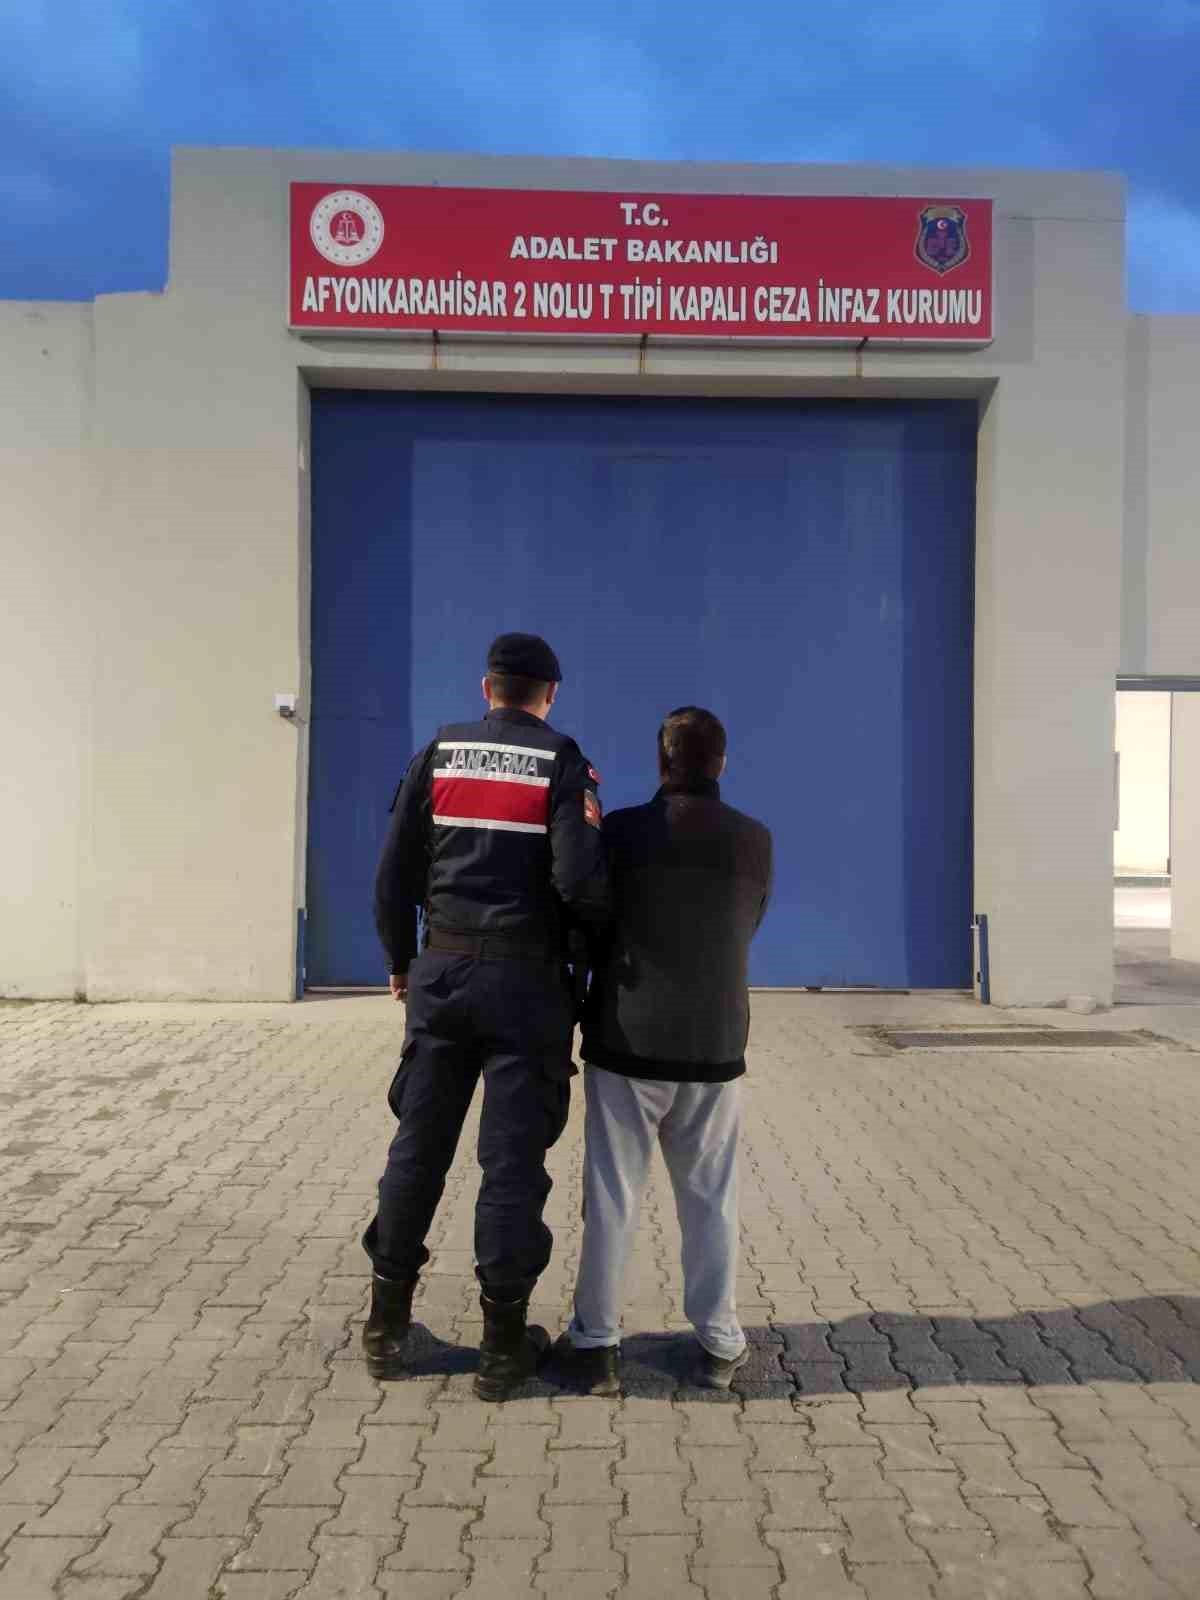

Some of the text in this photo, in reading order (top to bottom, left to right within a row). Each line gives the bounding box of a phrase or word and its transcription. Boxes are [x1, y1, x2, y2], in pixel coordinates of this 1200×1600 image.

[620, 202, 669, 226] T.C.
[510, 236, 778, 264] ADALET BAKANLIĞI
[302, 271, 982, 325] AFYONKARAHİSAR 2 NOLU T TİPİ KAPALI CEZA İNFAZ KURUMU
[445, 749, 538, 776] JANDARMA
